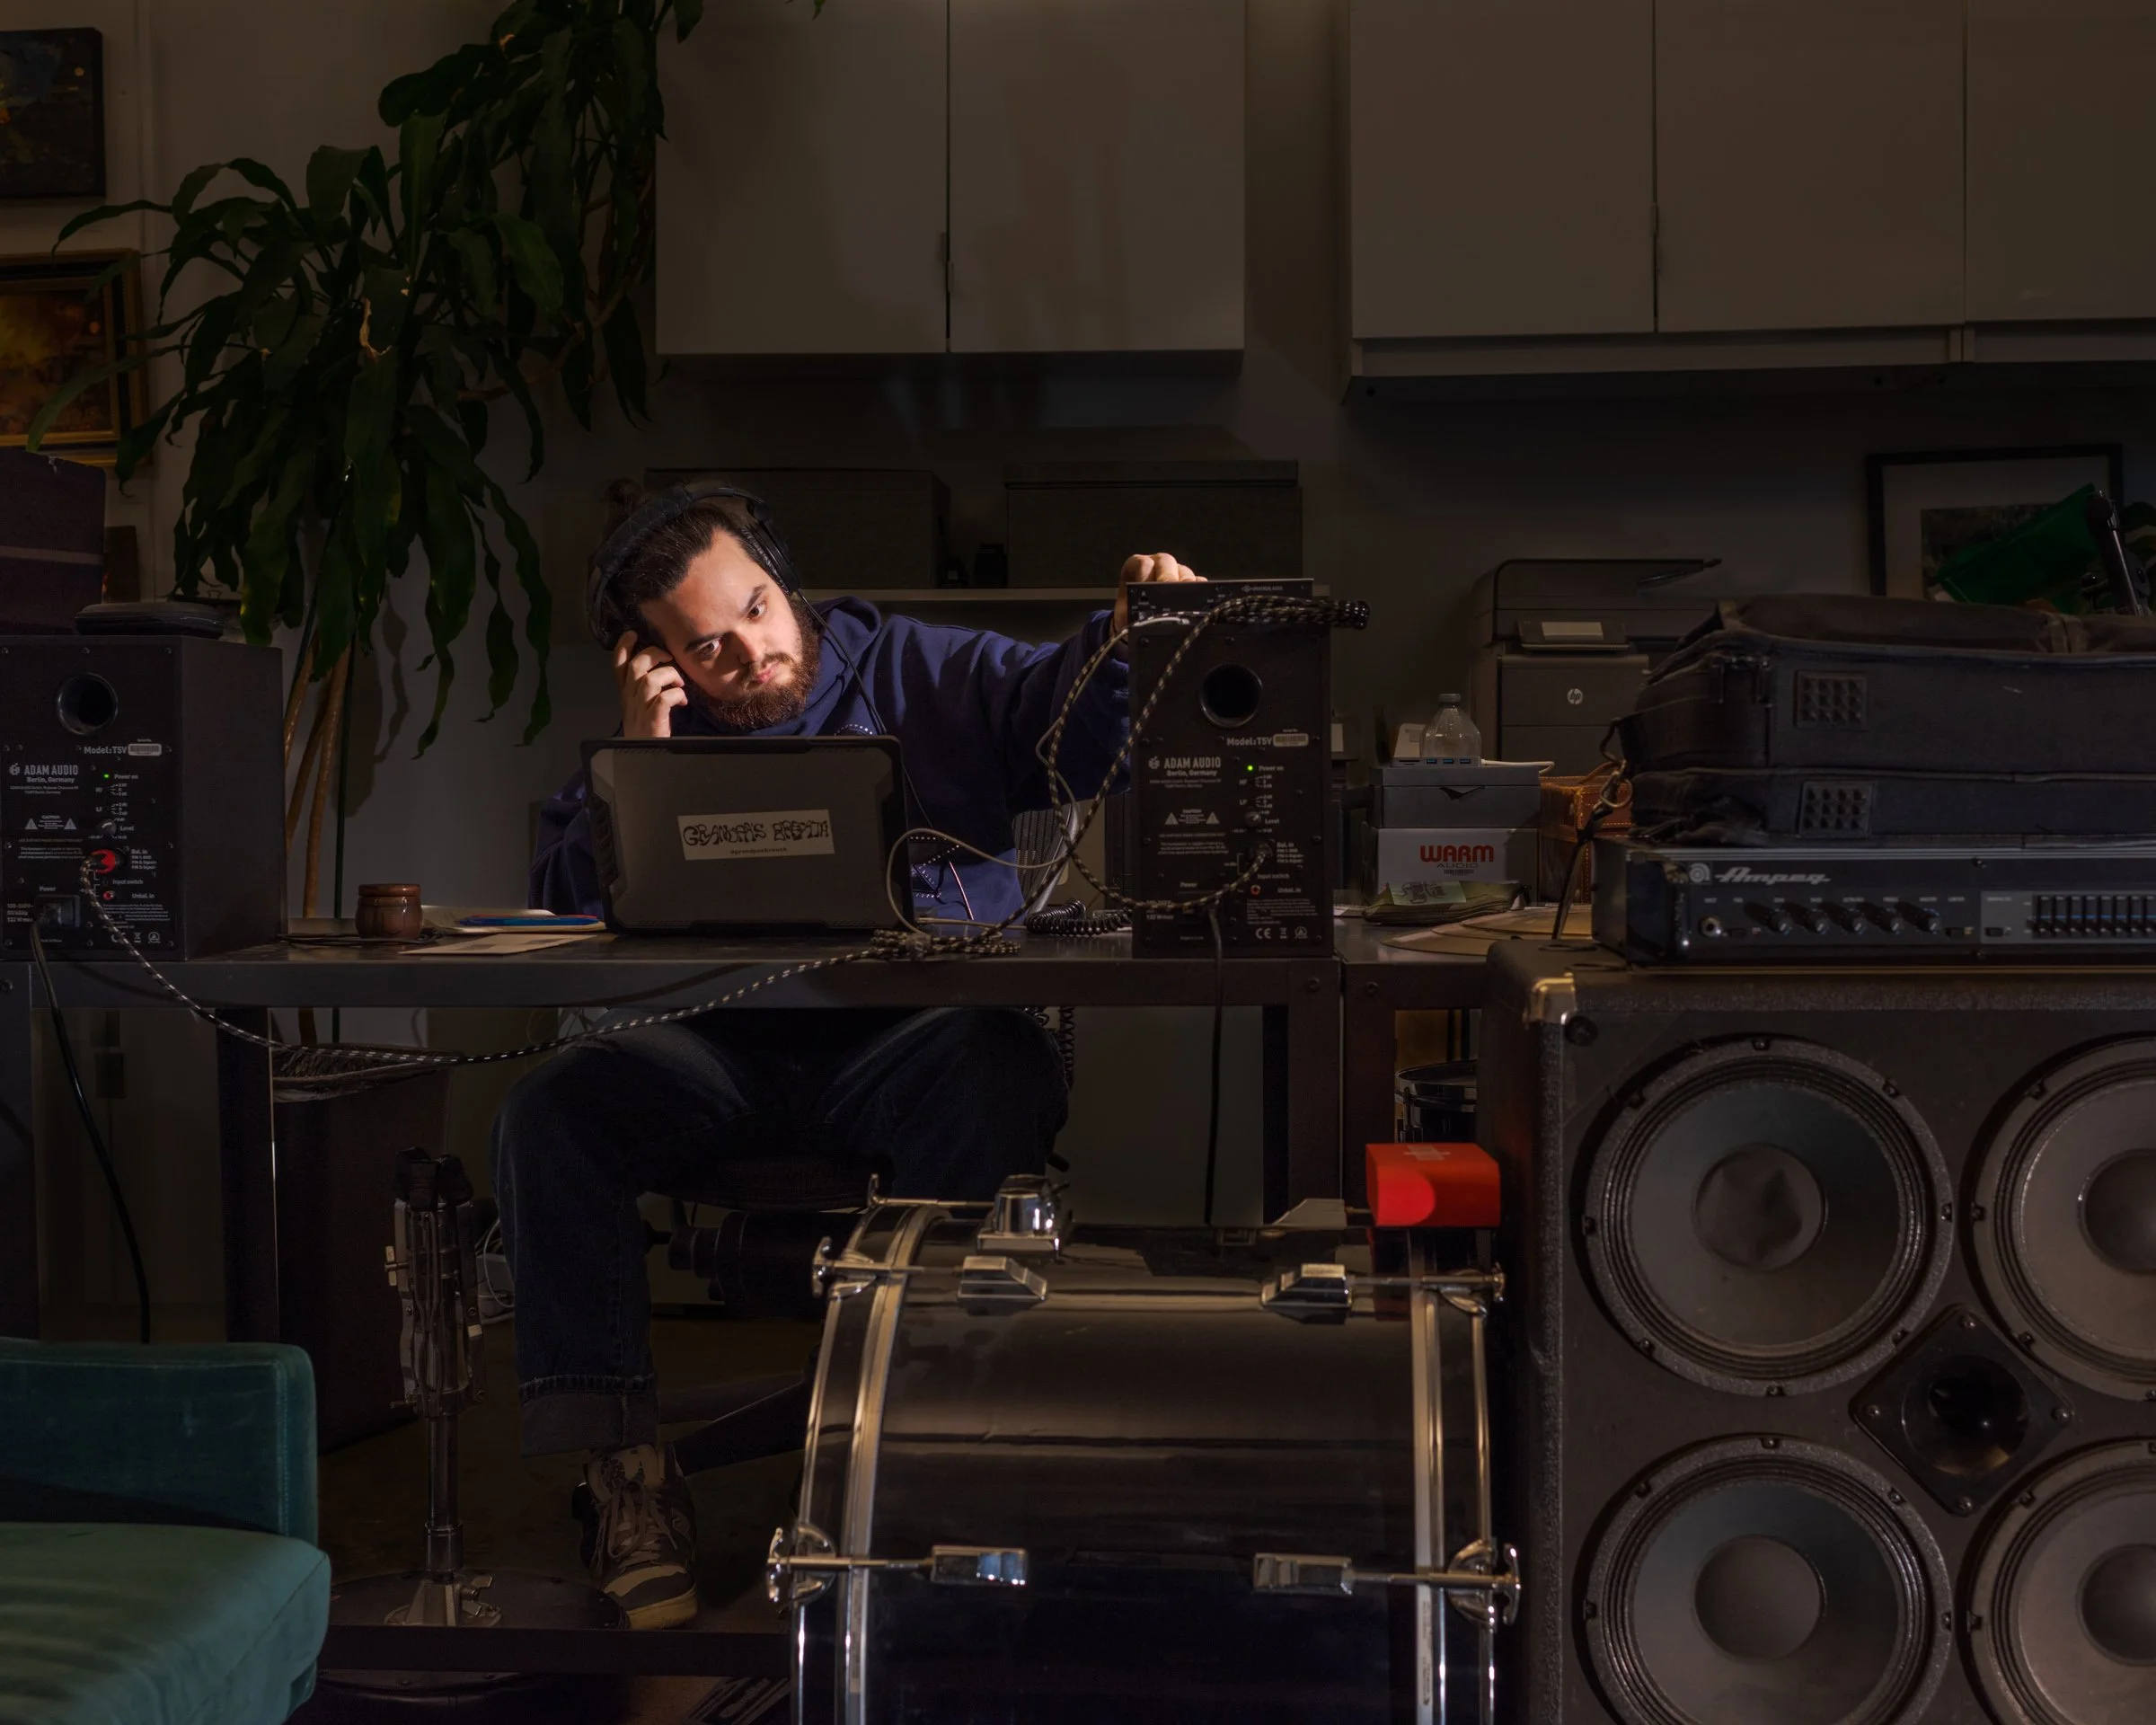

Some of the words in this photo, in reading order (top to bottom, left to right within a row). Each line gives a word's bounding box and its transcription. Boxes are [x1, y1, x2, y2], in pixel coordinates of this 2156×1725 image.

[1568, 688, 1582, 704] hp
[1163, 756, 1191, 769] ADAM
[1192, 756, 1222, 769] AUDIO
[24, 765, 49, 775] ADAM
[51, 765, 79, 775] AUDIO
[48, 776, 75, 784] Germany
[1420, 845, 1494, 862] WARM
[1714, 866, 1832, 885] Ampeg
